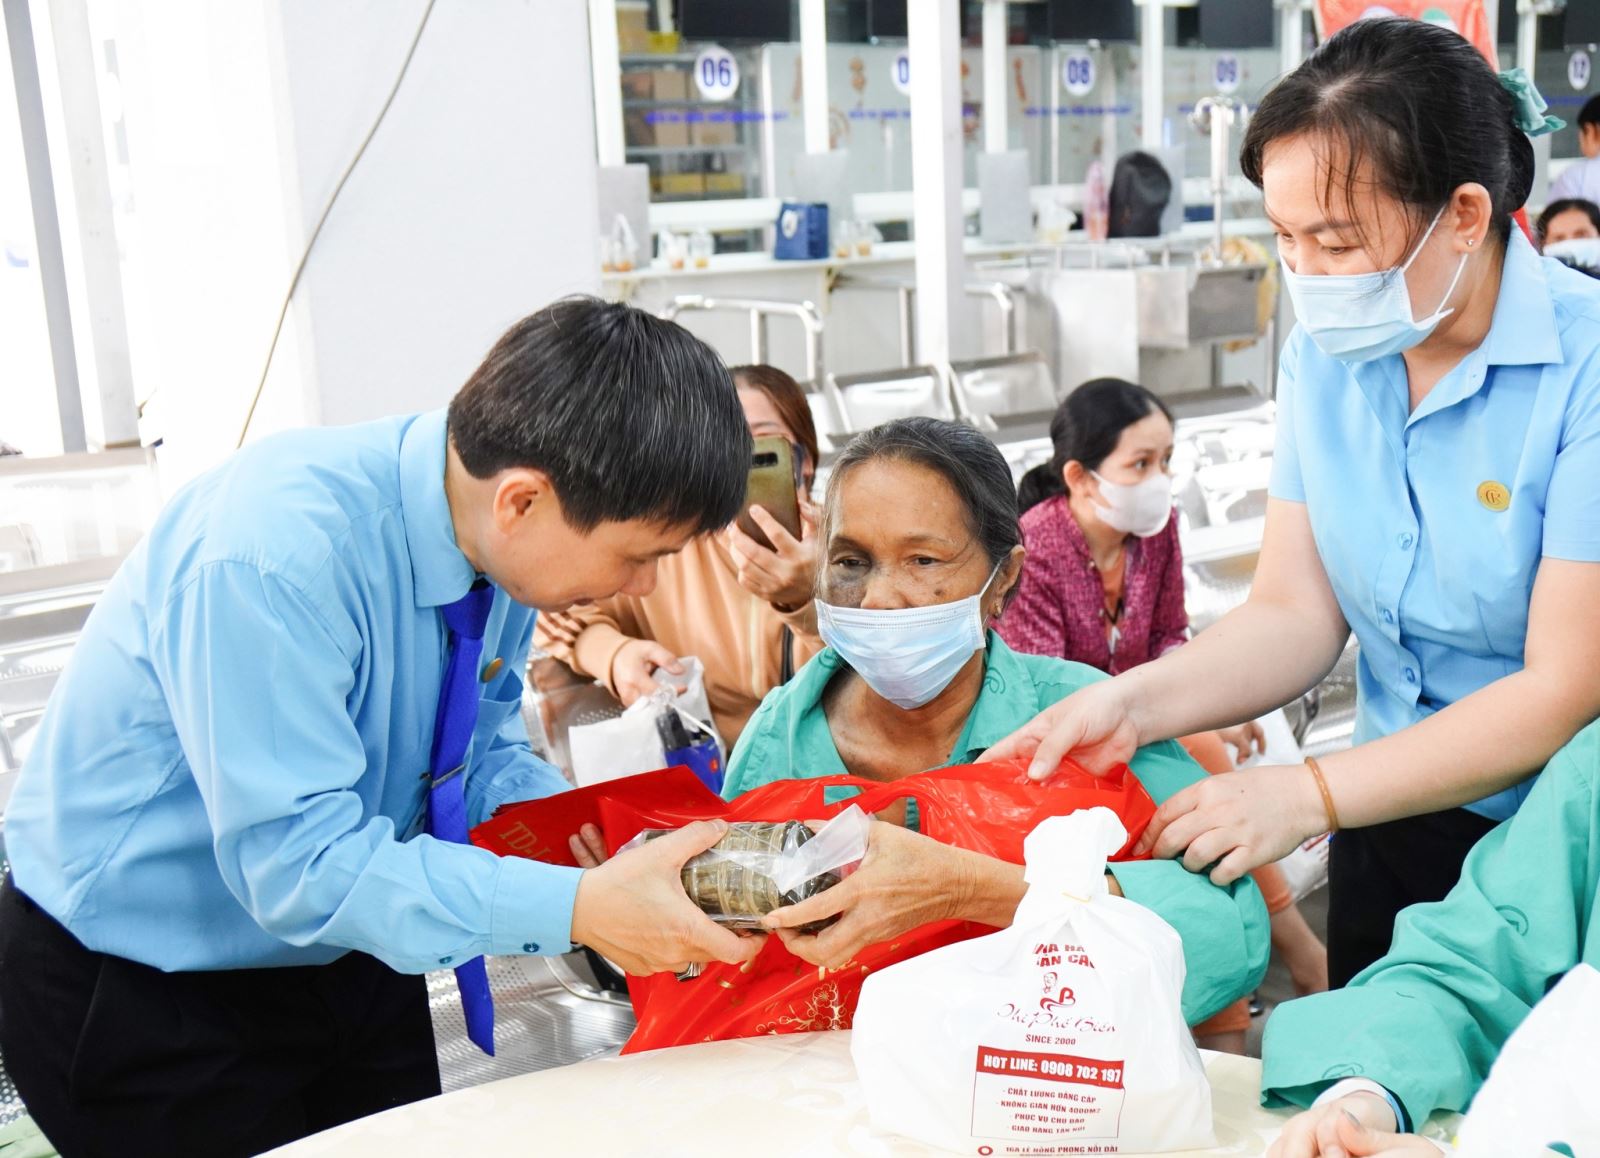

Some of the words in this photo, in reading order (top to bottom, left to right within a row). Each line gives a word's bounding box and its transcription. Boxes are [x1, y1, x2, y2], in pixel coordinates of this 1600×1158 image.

[702, 58, 731, 87] 06
[1067, 59, 1090, 85] 08
[1025, 1034, 1053, 1045] SINCE
[1055, 1037, 1076, 1046] 2000
[983, 1054, 1008, 1069] HOT
[1009, 1057, 1038, 1072] LINE:
[1040, 1060, 1074, 1077] 0908
[1076, 1066, 1098, 1080] 702
[1101, 1069, 1121, 1083] 197
